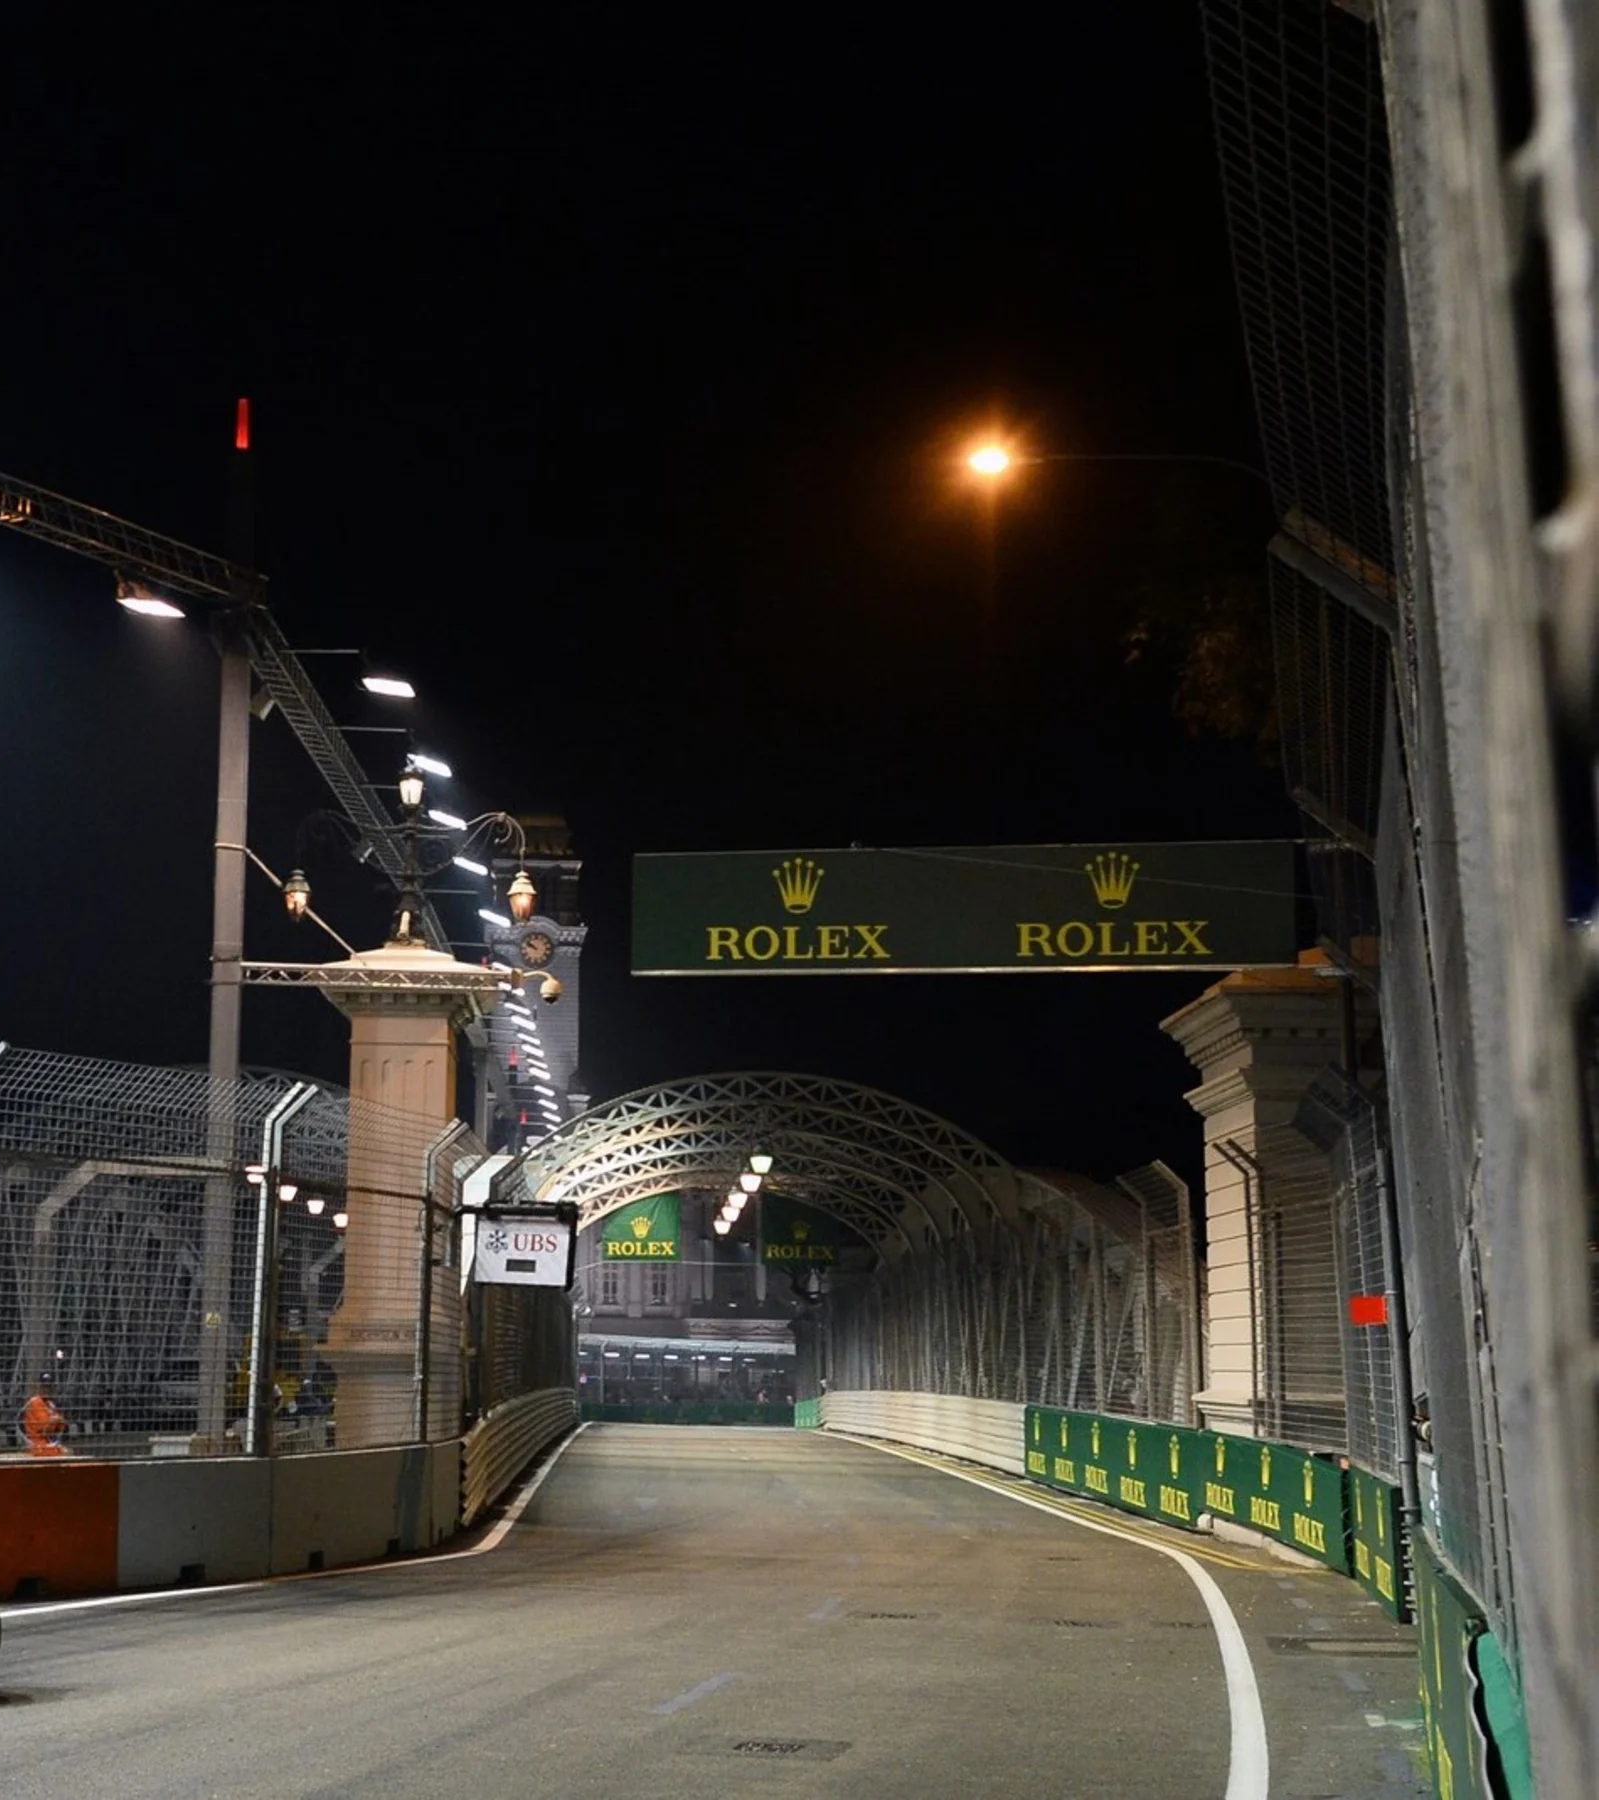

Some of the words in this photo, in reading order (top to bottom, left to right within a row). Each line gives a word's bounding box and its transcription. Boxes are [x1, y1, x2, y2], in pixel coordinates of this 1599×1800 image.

[707, 924, 889, 961] ROLEX
[1018, 920, 1210, 957] ROLEX
[513, 1233, 558, 1253] UBS
[607, 1241, 675, 1257] ROLEX
[765, 1244, 834, 1260] ROLEX
[1120, 1476, 1147, 1508] ROLEX
[1160, 1485, 1190, 1522] ROLEX
[1205, 1482, 1235, 1515] ROLEX
[1250, 1496, 1282, 1532] ROLEX
[1293, 1513, 1327, 1554] ROLEX
